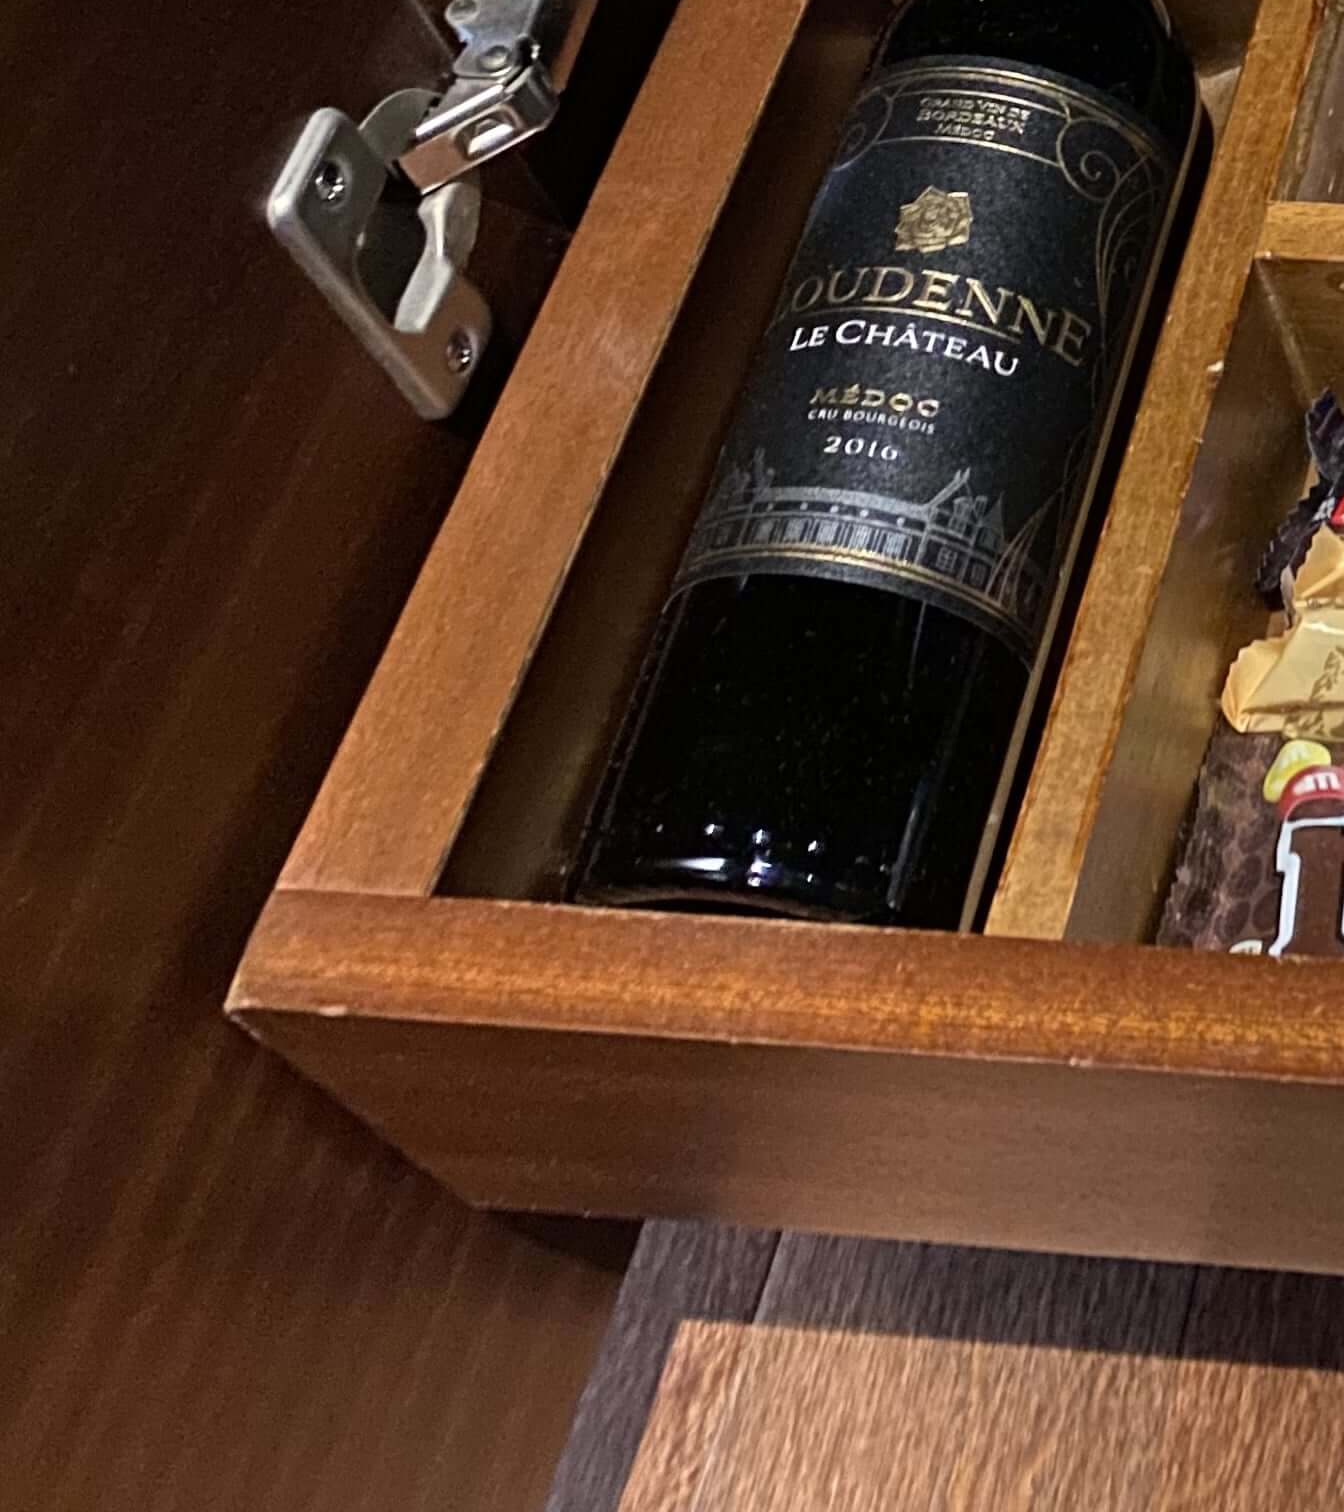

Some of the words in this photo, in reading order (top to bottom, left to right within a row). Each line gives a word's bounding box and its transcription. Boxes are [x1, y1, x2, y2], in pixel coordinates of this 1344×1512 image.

[916, 108, 1026, 135] BORDEAUX
[789, 325, 829, 352] LE
[834, 319, 1020, 377] CHÂTEAU
[808, 383, 941, 417] MÉDOC
[807, 408, 837, 422] CRU
[842, 409, 936, 436] BOURGEOIS
[823, 436, 900, 462] 2016
